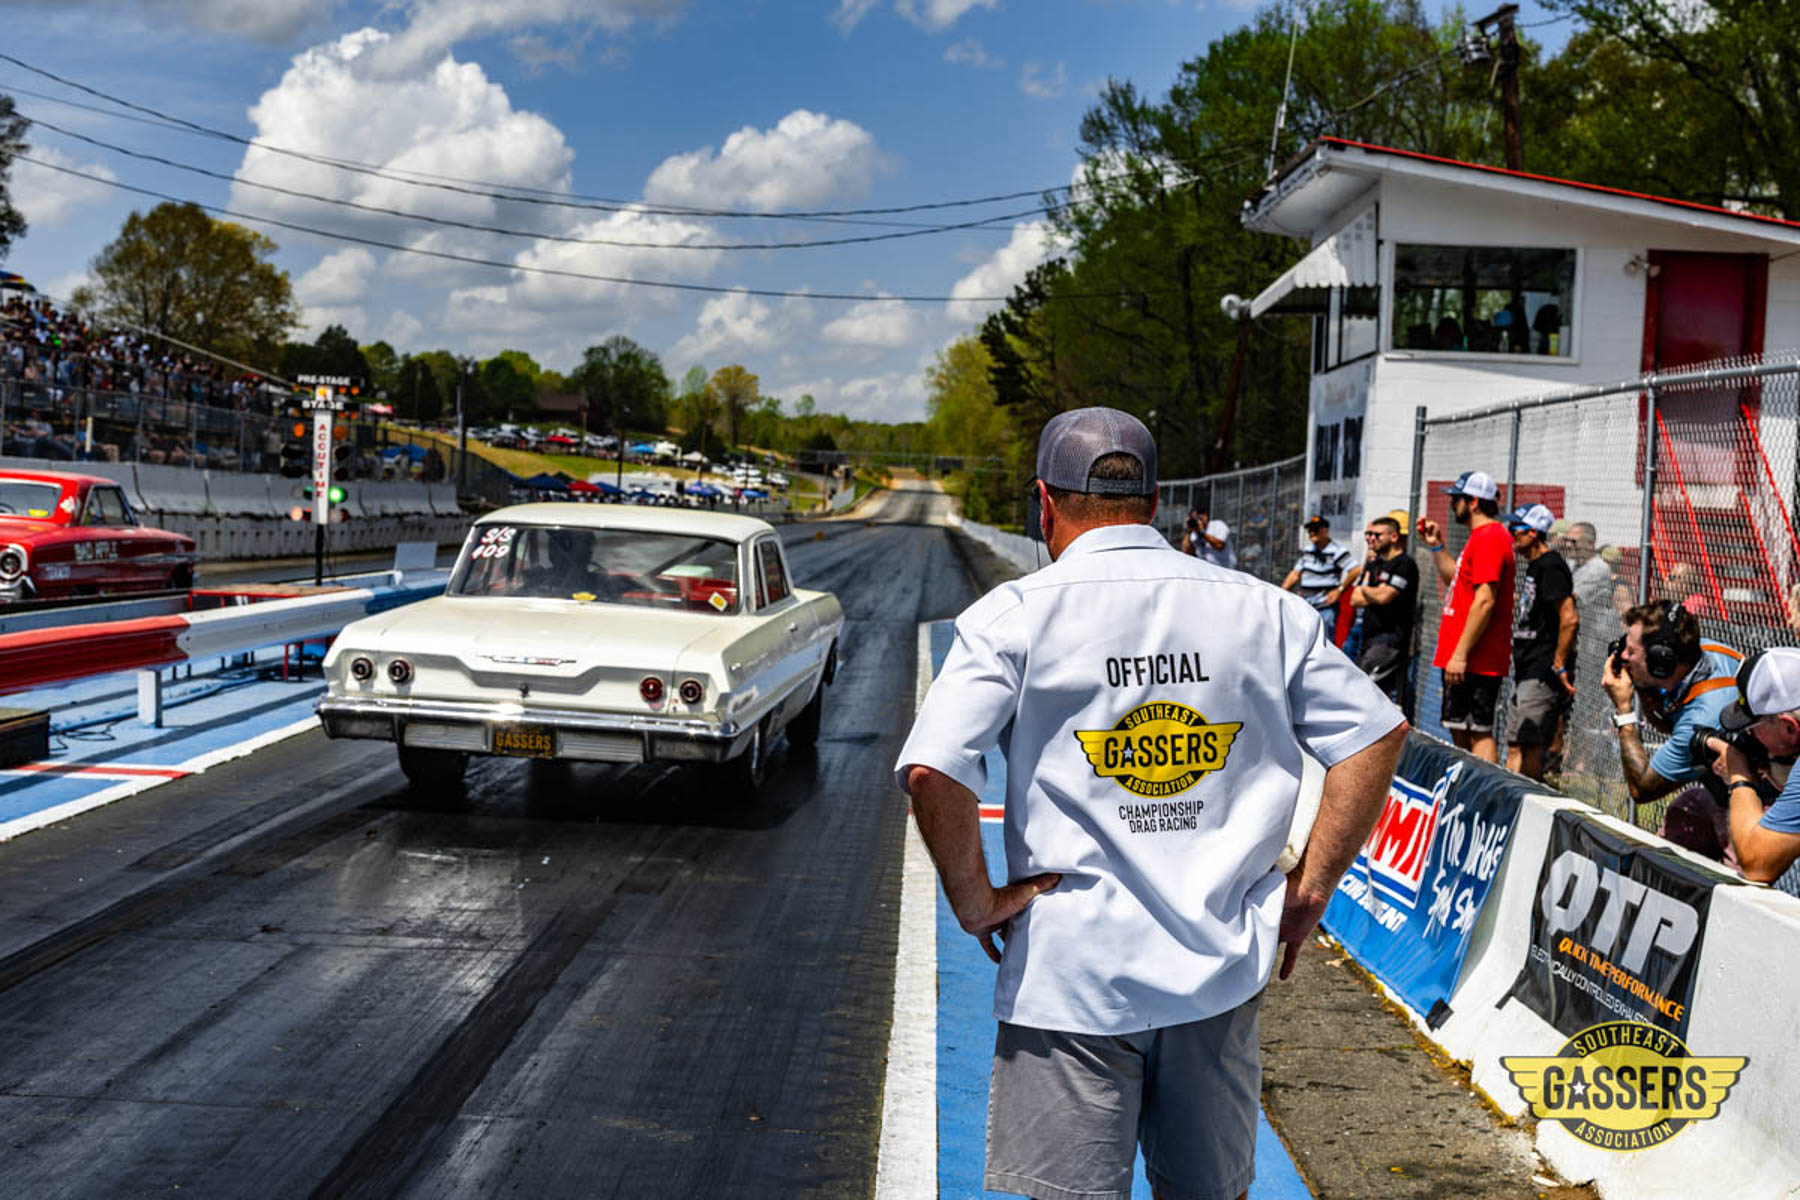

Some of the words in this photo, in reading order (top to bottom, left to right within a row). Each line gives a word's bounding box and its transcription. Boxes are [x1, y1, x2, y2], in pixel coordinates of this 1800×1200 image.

[297, 374, 350, 385] PRE-STAGE
[302, 400, 345, 410] STAGE
[480, 526, 517, 544] S/S
[470, 544, 510, 560] 409
[1106, 652, 1209, 687] OFFICIAL
[1125, 704, 1199, 730] SOUTHEAST
[495, 730, 552, 751] GASSERS
[1104, 731, 1218, 769] GASSERS
[1125, 773, 1196, 796] ASSOCIATION
[1118, 800, 1204, 821] CHAMPIONSHIP
[1129, 818, 1158, 833] DRAG
[1159, 815, 1197, 832] RACING
[1541, 850, 1699, 975] QTP
[1559, 936, 1588, 964] QUICK
[1588, 952, 1611, 977] TIME
[1608, 964, 1685, 1022] PERFORMANCE
